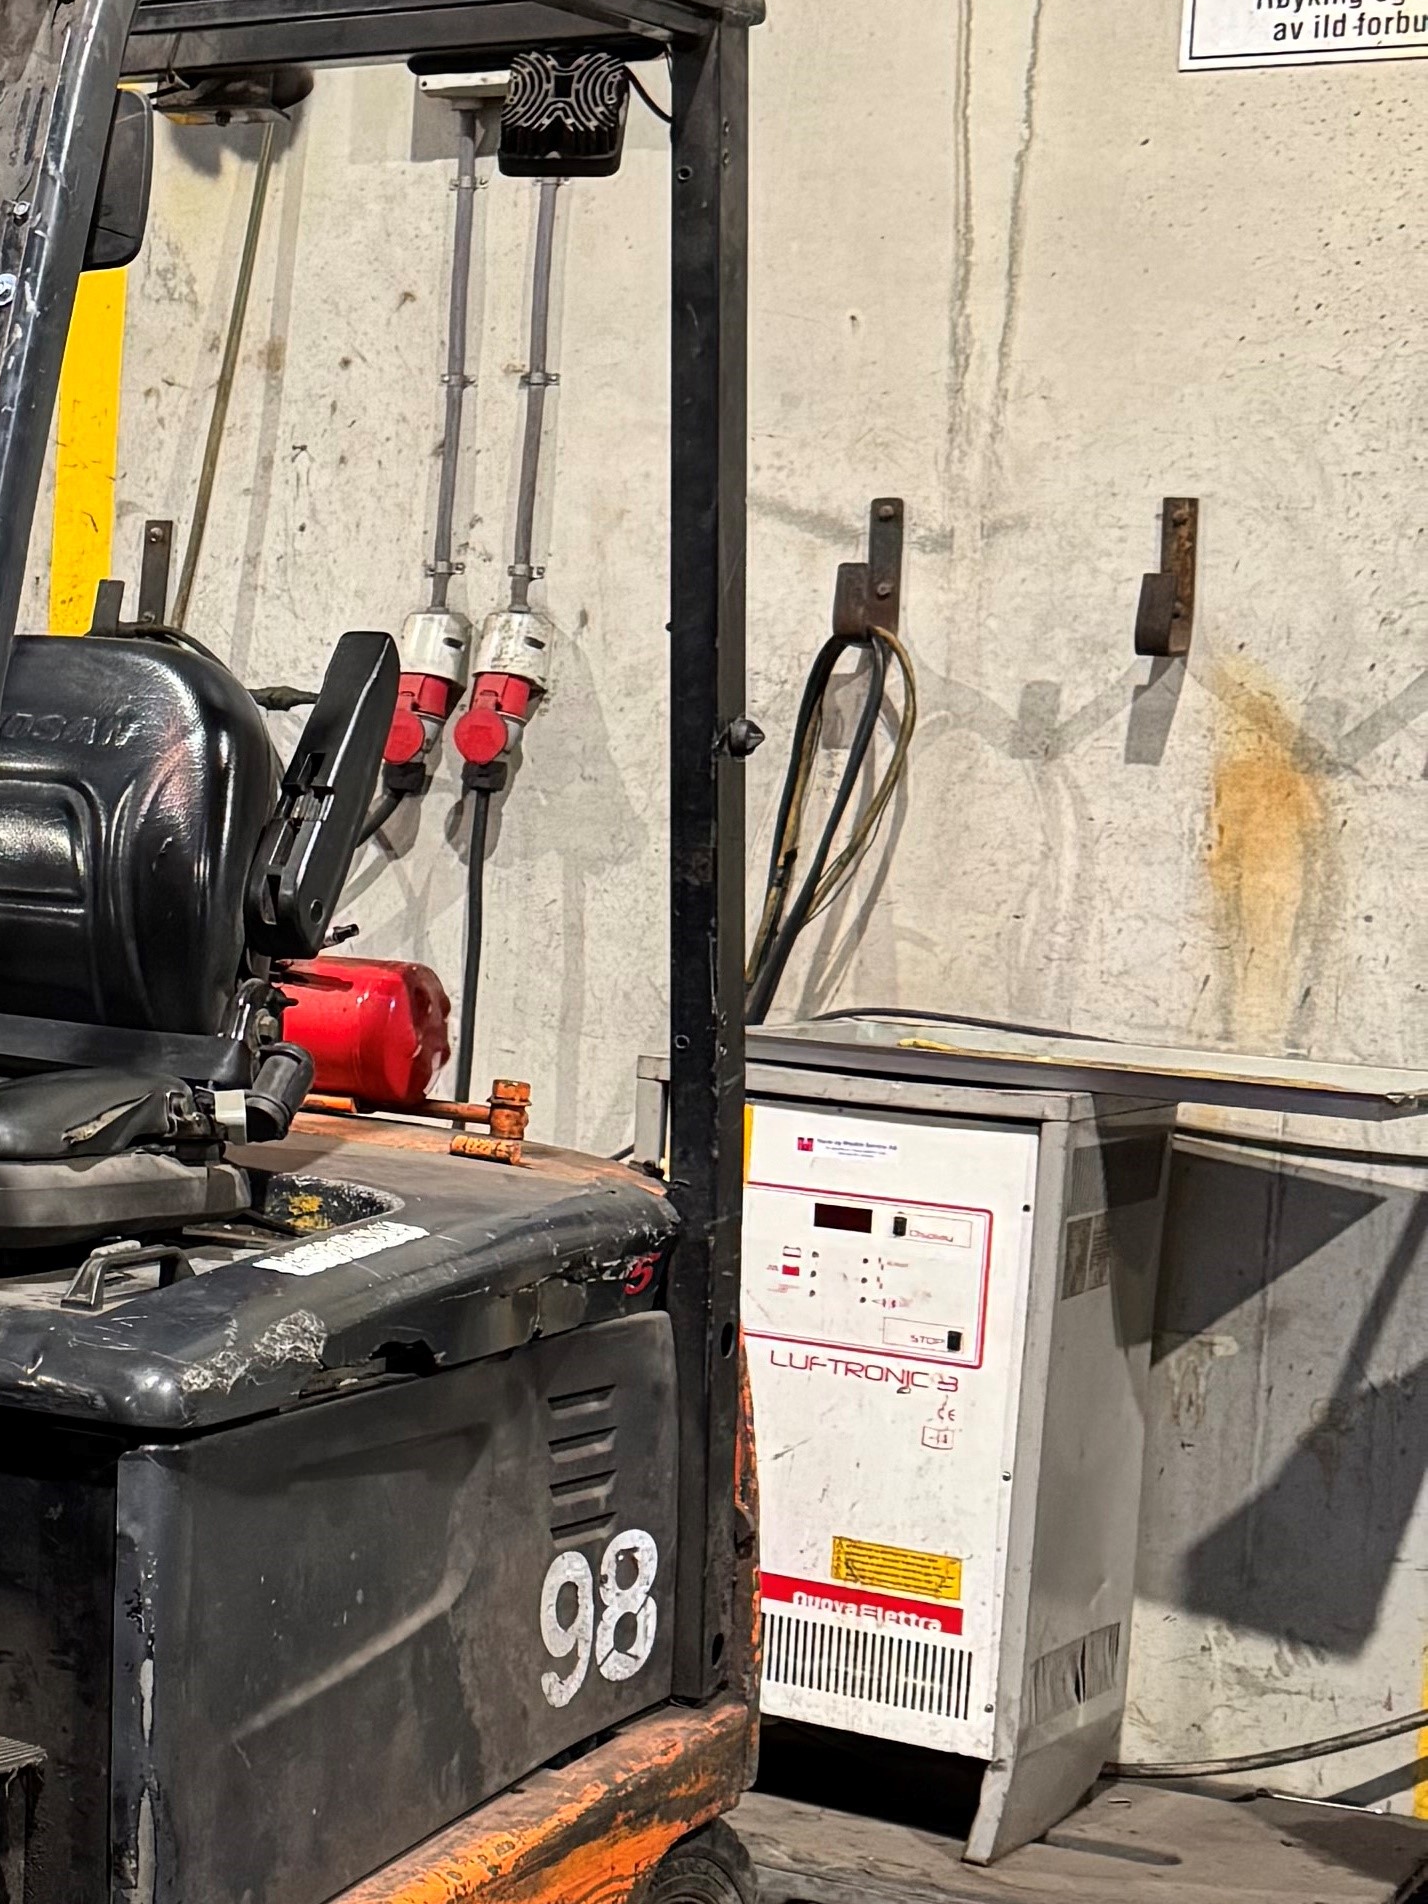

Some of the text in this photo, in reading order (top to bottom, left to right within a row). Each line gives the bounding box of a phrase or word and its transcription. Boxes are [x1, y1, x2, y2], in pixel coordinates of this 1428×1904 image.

[1273, 10, 1428, 42] av ild forbu
[910, 1334, 945, 1345] STOP
[770, 1350, 930, 1389] LUFTRONIC
[540, 1528, 659, 1708] 98
